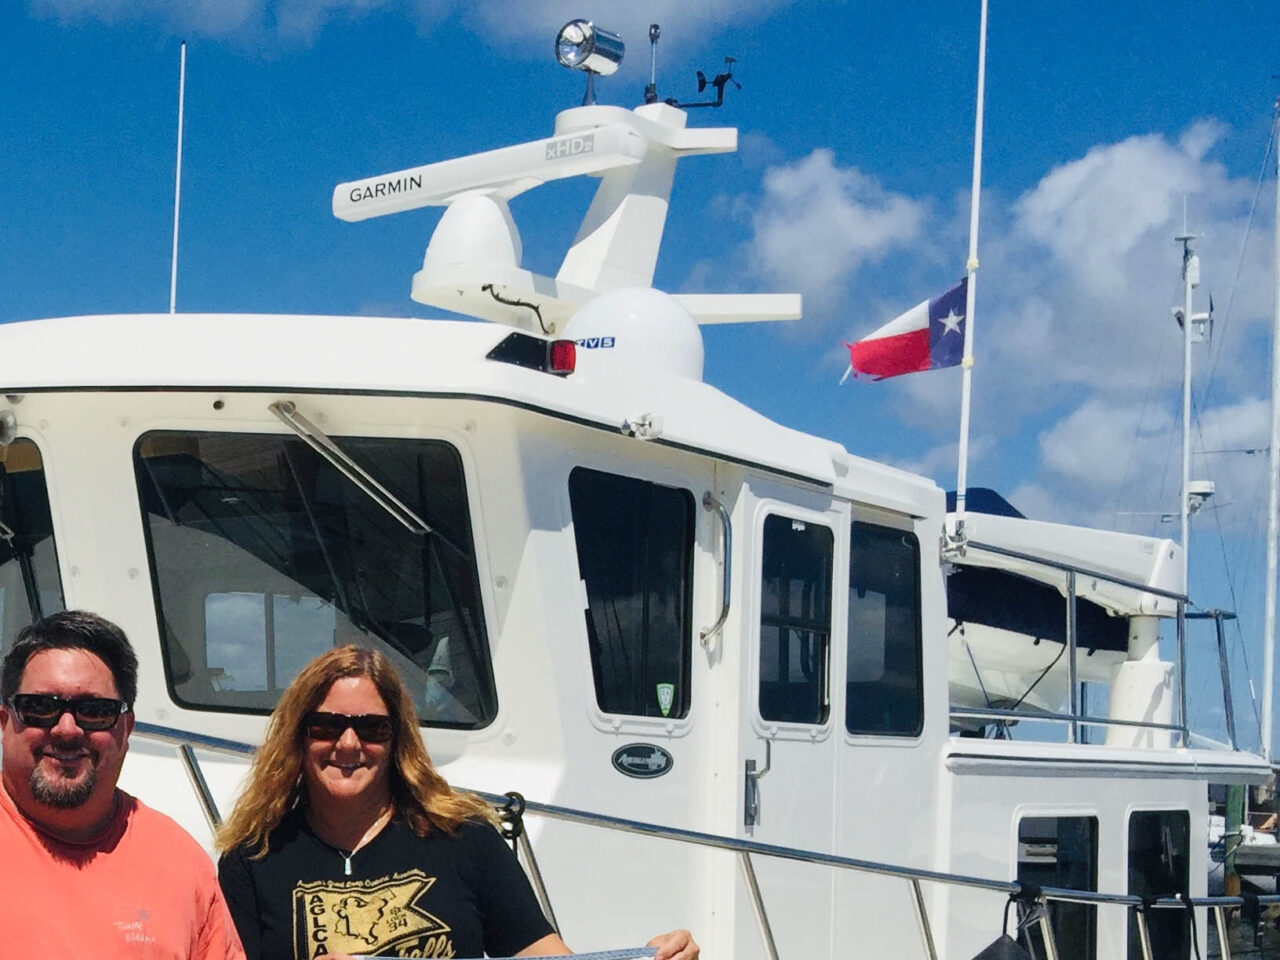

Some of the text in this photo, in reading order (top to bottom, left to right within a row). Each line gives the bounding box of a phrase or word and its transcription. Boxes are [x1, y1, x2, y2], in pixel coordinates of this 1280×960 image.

[349, 174, 422, 203] GARMIN
[309, 894, 329, 960] AGLCA
[389, 918, 408, 933] 34
